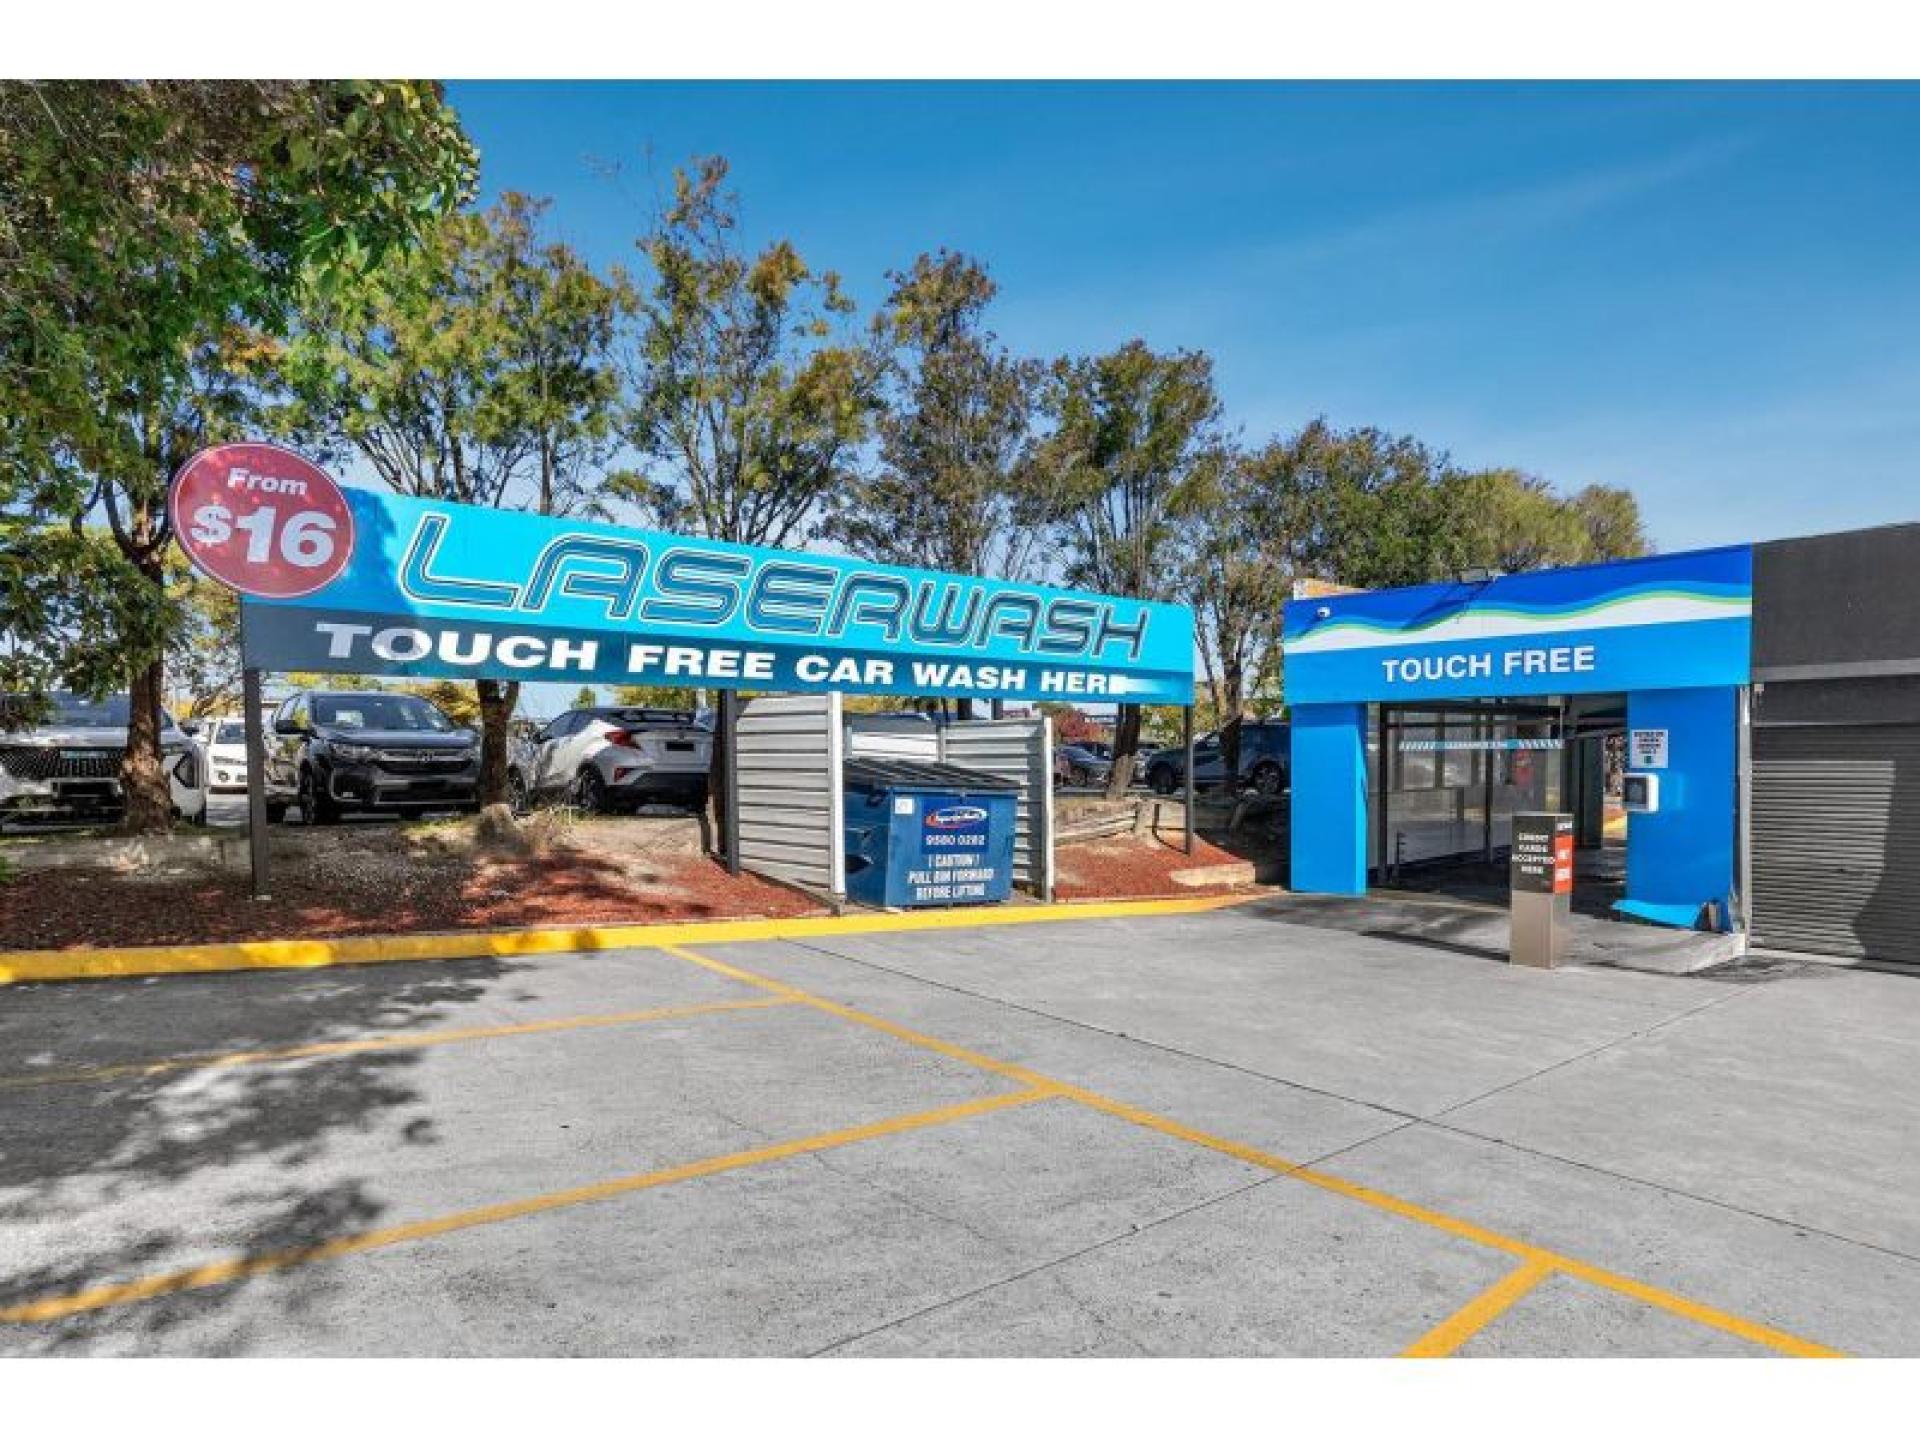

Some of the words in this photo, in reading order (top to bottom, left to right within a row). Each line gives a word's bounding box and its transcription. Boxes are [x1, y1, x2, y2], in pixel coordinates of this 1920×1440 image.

[228, 467, 307, 495] From
[191, 505, 337, 568] $16
[399, 511, 1149, 662] LASERWASH
[315, 623, 598, 670] TOUCH
[627, 643, 776, 680] FREE
[796, 654, 894, 685] CAR
[912, 661, 1026, 692] WASH
[1381, 652, 1491, 683] TOUCH
[1504, 645, 1595, 675] FREE
